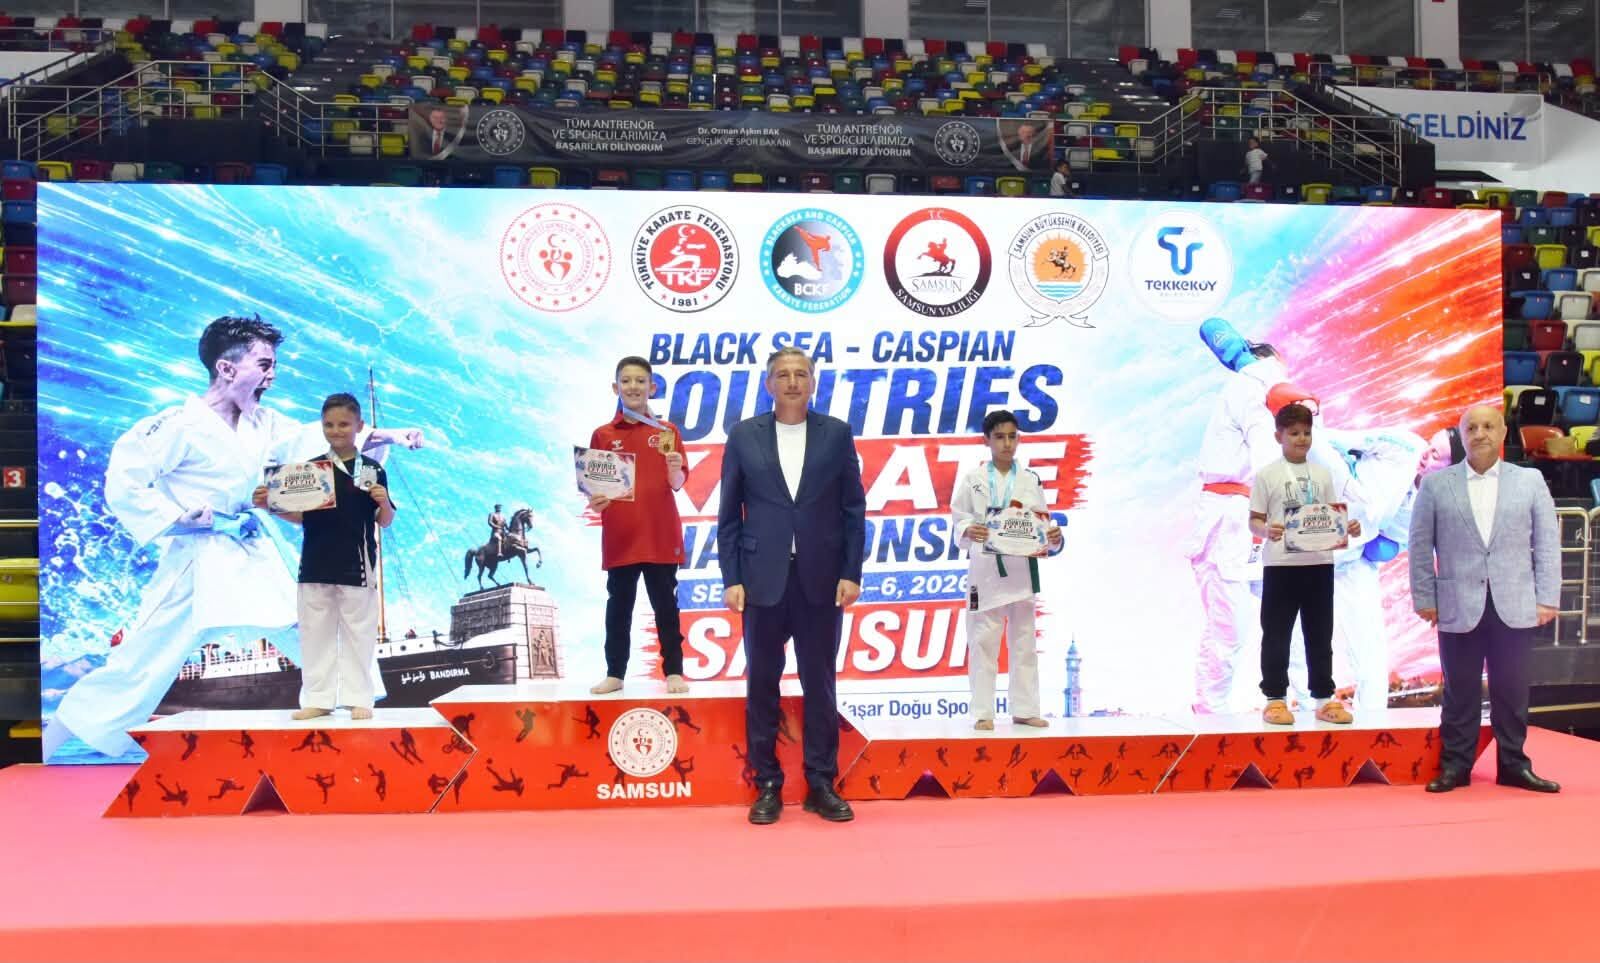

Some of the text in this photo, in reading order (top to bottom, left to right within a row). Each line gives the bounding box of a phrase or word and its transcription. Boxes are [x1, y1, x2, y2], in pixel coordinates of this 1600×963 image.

[564, 117, 655, 130] TÜM ANTRENÖR
[816, 121, 903, 135] TÜM ANTRENÖR
[551, 129, 668, 141] VE SPORCULARIMIZA
[697, 127, 709, 135] Dr.
[711, 127, 738, 135] Osman
[555, 141, 664, 152] BAŞARILAR DİLİYORUM
[686, 137, 791, 147] GENÇLİK VE SPOR BAKANI
[803, 134, 914, 146] VE SPORCULARIMIZA
[807, 146, 912, 157] BAŞARILAR DİLİYORUM
[1013, 226, 1035, 253] SAMSUN
[646, 210, 691, 236] KARATE
[697, 213, 734, 291] FEDERASYONU
[660, 271, 713, 286] TKF
[911, 278, 963, 293] SAMSUN
[671, 297, 699, 307] 1981
[896, 288, 937, 315] SAMSUN
[650, 332, 760, 365] BLACK
[872, 330, 1016, 362] CASPIAN
[8, 470, 21, 488] 3
[842, 701, 885, 720] aşar
[889, 697, 932, 719] Doğu
[596, 780, 693, 799] SAMSUN
